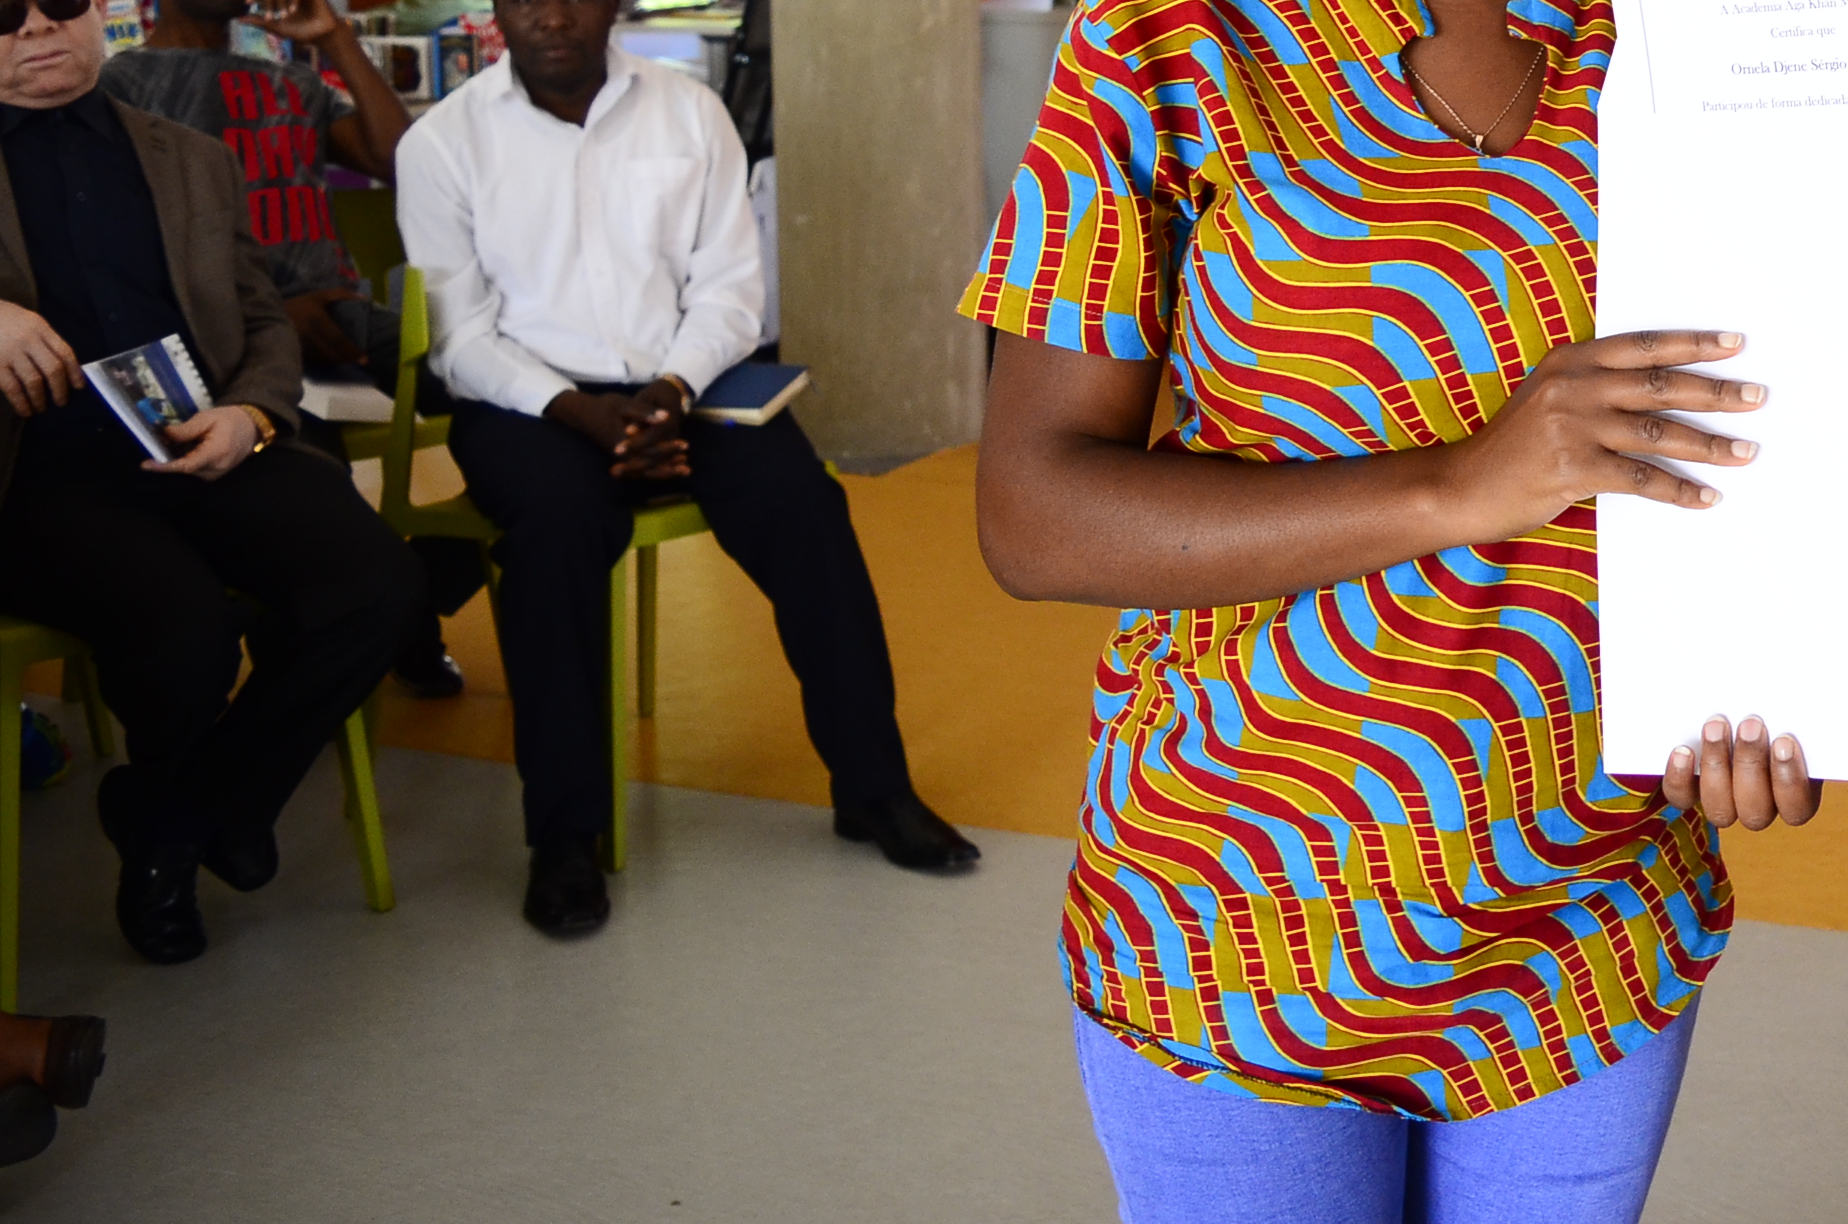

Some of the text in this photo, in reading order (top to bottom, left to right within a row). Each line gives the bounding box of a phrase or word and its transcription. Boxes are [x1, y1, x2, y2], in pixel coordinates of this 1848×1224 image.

[1720, 4, 1729, 15] A
[1732, 1, 1783, 15] Academia
[1785, 0, 1806, 12] Aga
[1770, 25, 1836, 39] Certifica que
[1730, 61, 1771, 75] Ornela
[1773, 60, 1808, 76] Djene
[1810, 57, 1848, 73] Sérgio
[219, 70, 309, 120] ALL
[1702, 100, 1753, 113] Participou
[1755, 98, 1768, 109] de
[1771, 97, 1802, 109] forma
